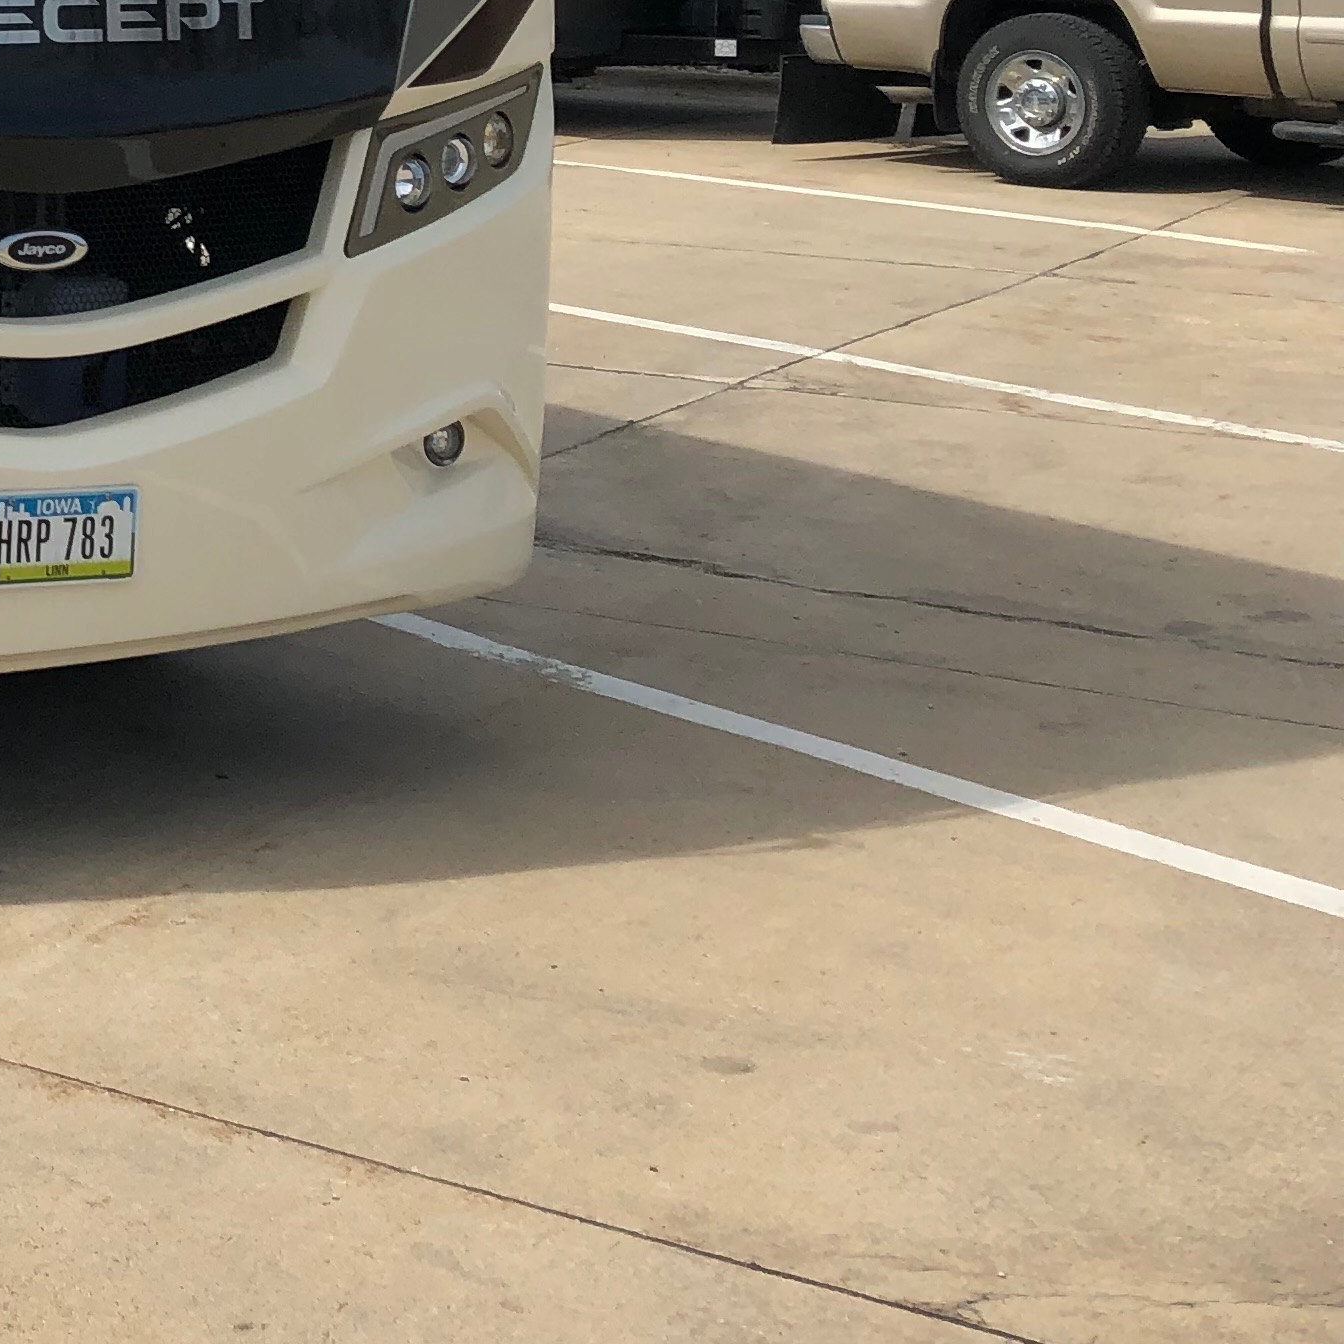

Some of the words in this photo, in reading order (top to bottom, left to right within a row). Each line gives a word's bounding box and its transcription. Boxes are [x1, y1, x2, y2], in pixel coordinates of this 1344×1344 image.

[17, 242, 67, 258] Jayco
[36, 497, 83, 515] IOWA
[63, 514, 115, 561] 783
[45, 564, 69, 577] LINN
